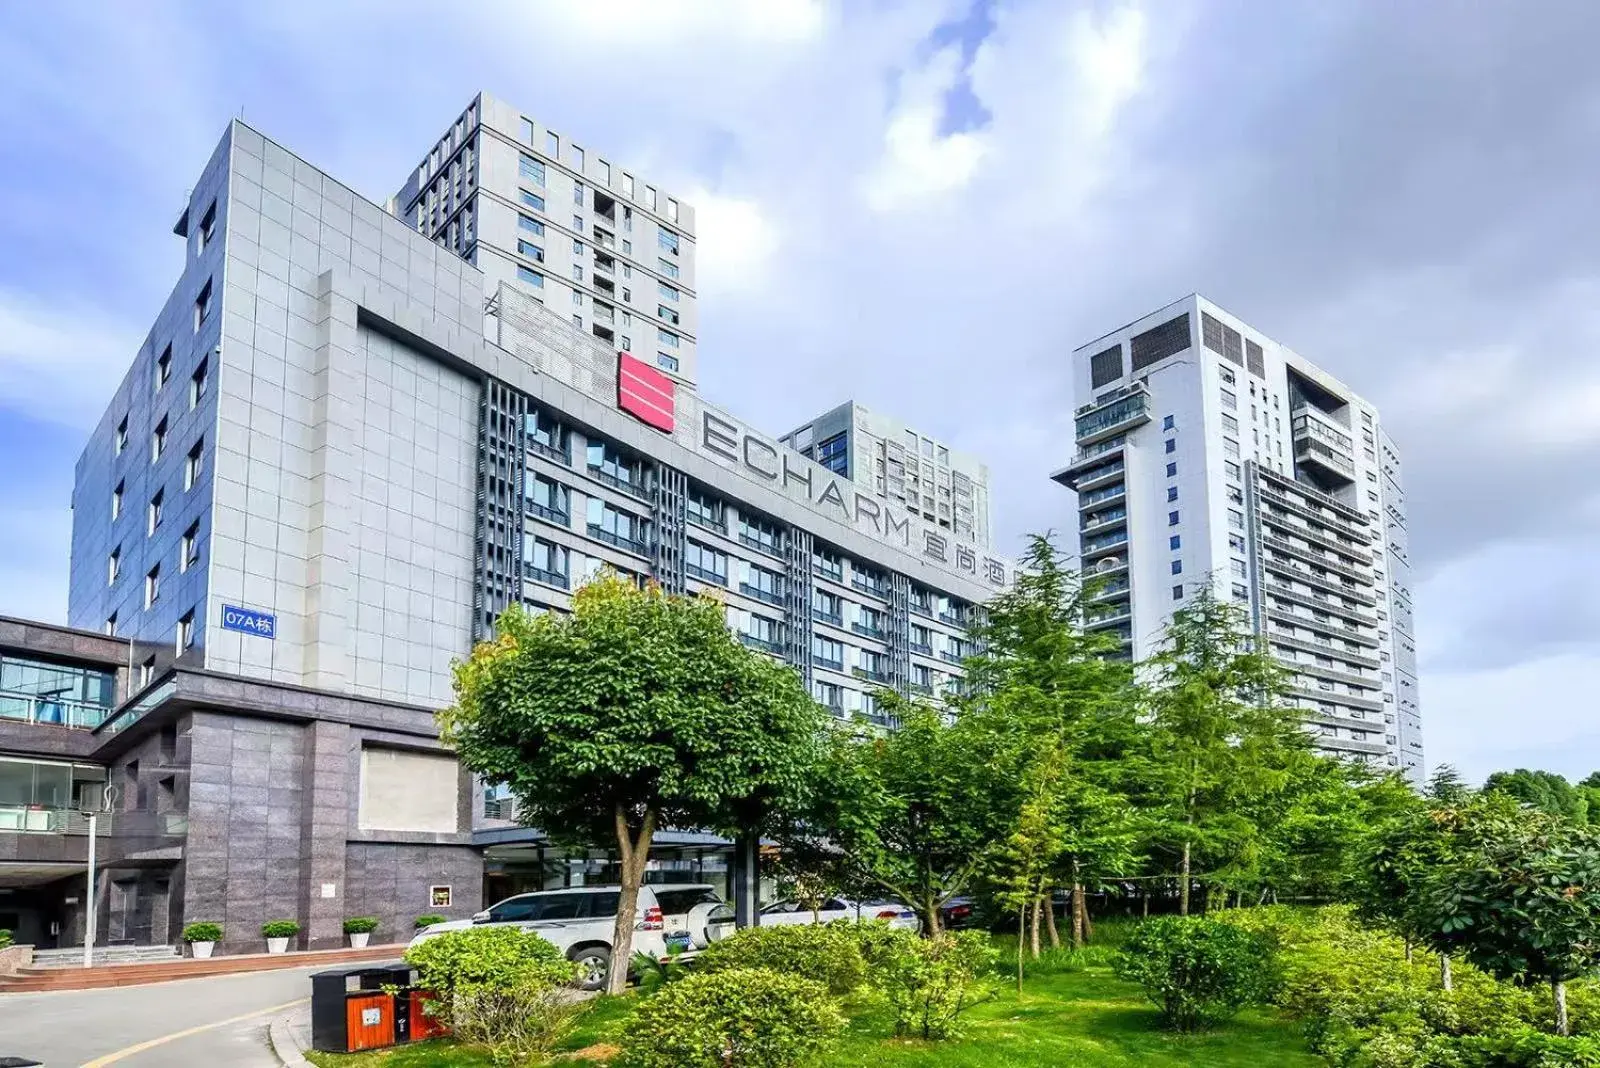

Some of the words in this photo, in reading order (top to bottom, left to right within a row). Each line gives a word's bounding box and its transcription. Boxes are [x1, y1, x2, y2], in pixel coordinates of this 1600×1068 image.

[702, 410, 909, 546] ECHARM
[923, 529, 1022, 591] 宜尚酒
[226, 611, 272, 633] 07A栋
